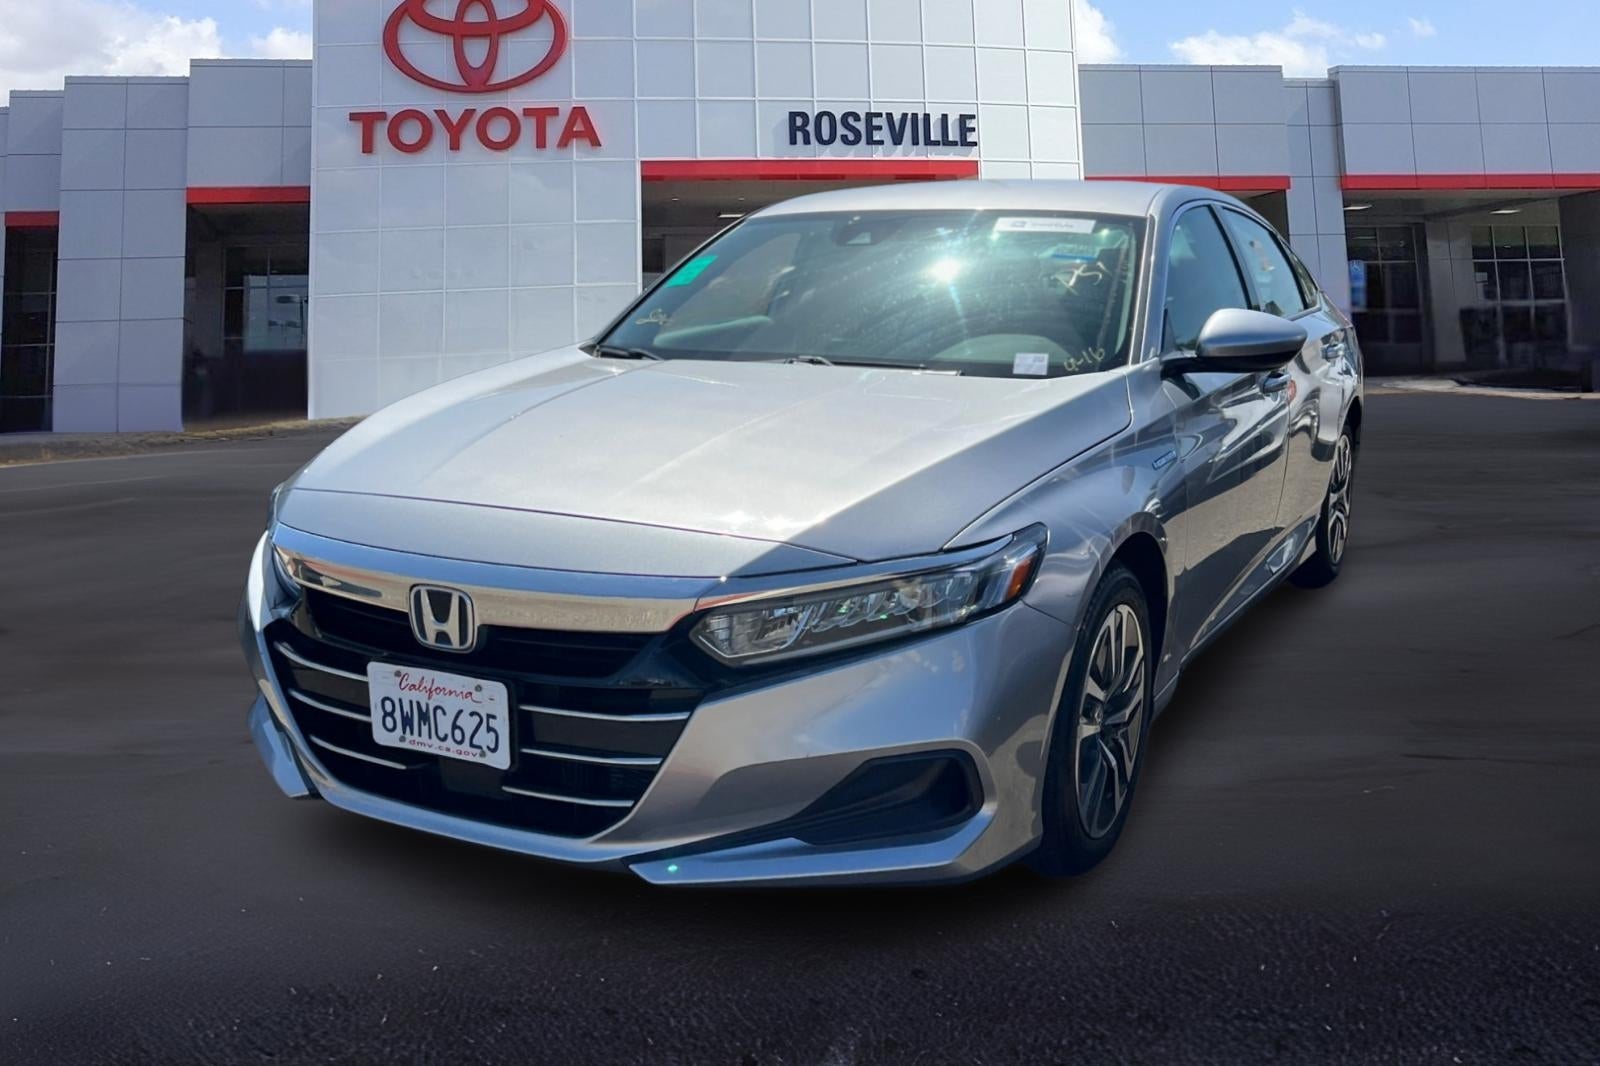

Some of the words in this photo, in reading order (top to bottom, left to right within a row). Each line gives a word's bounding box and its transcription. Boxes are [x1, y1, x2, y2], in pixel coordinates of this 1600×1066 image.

[349, 106, 602, 154] TOYOTA
[788, 110, 978, 147] ROSEVILLE
[399, 672, 482, 704] California
[380, 696, 499, 753] 8WMC625
[408, 738, 478, 758] dmv.ca.gov
